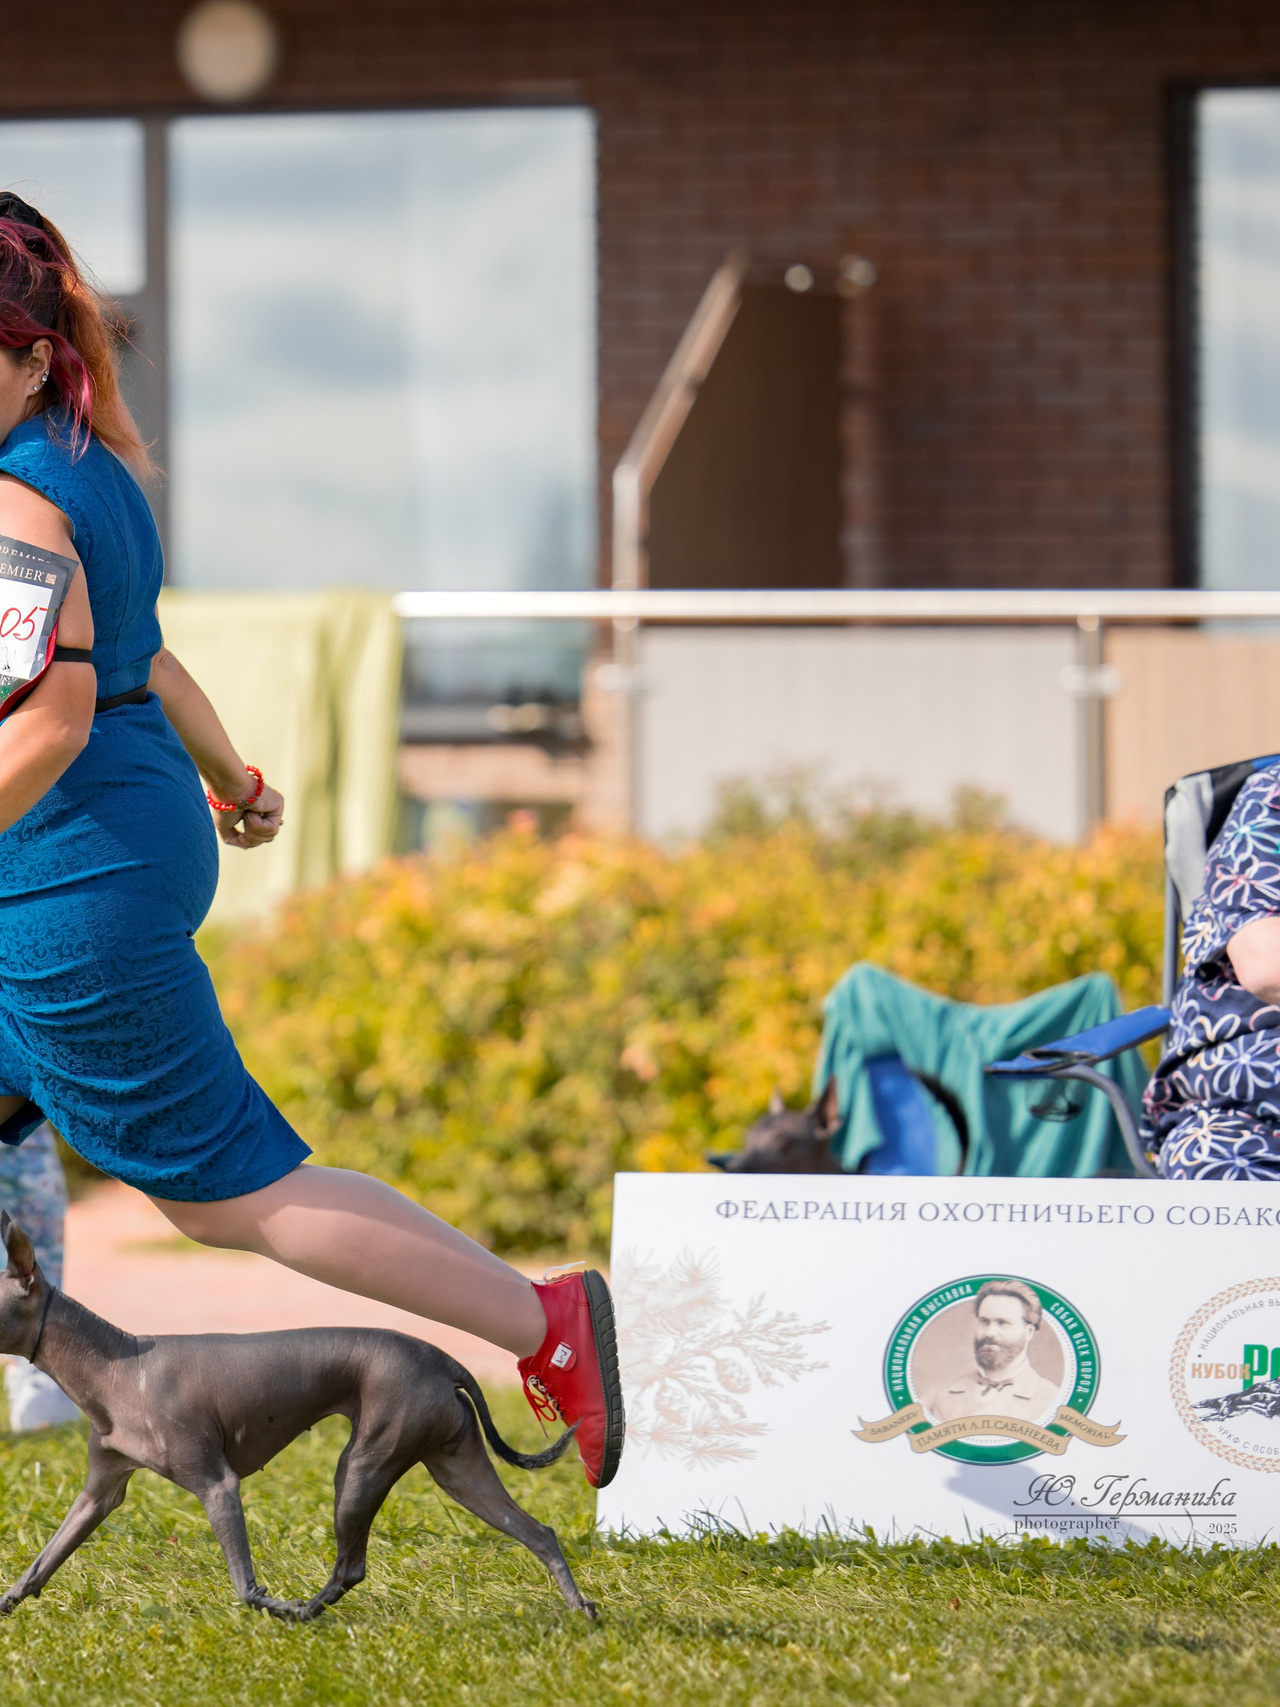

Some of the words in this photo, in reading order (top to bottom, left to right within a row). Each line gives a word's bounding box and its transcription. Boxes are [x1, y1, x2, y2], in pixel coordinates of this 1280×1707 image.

[716, 1199, 907, 1223] ФЕДЕРАЦИЯ
[918, 1201, 1154, 1225] ОХОТНИЧЬЕГО
[1167, 1205, 1280, 1226] СОБАК
[1050, 1302, 1078, 1330] СОБАК
[1199, 1300, 1265, 1350] НАЦИОНАЛЬНАЯ
[891, 1315, 923, 1391] НАЦИОНАЛЬНАЯ
[920, 1284, 973, 1316] ВЫСТАВКА
[1073, 1332, 1090, 1356] ВСЕХ
[1076, 1361, 1092, 1393] ПОРОД
[1192, 1363, 1250, 1380] КУБОК
[870, 1411, 918, 1434] SABANEEV
[916, 1423, 967, 1447] ПАМЯТИ
[1059, 1414, 1111, 1438] MEMORIAL
